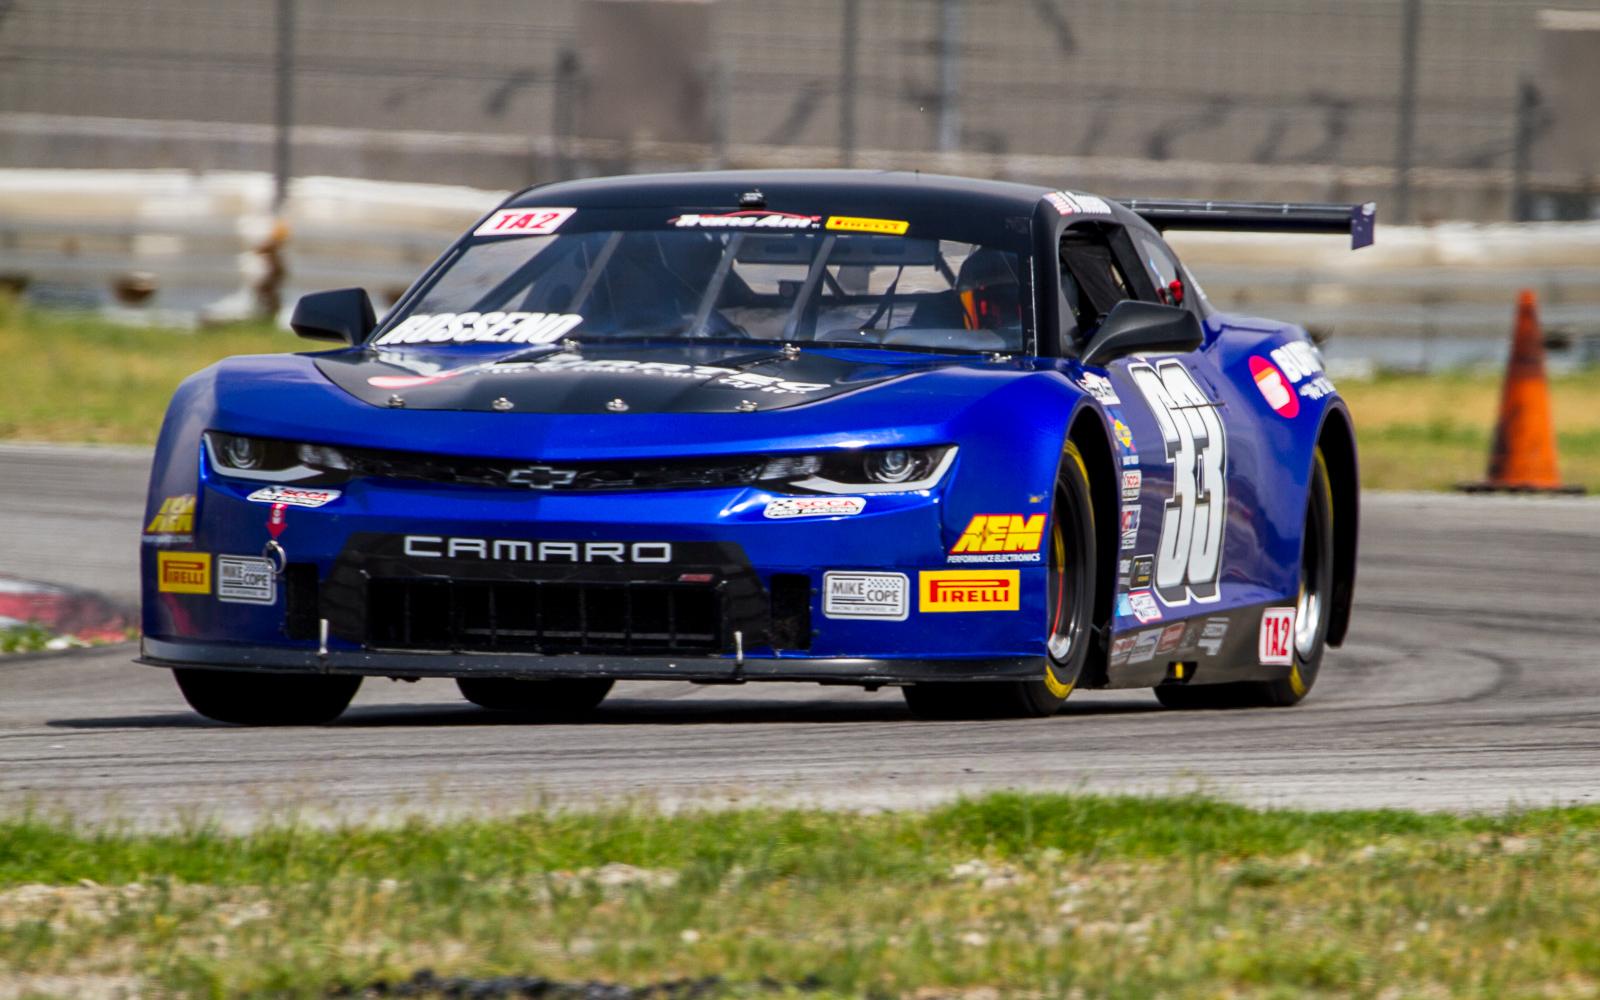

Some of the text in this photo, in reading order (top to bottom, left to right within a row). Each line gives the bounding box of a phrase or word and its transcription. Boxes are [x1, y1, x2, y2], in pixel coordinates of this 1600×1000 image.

[494, 212, 560, 230] TA2
[1128, 358, 1227, 607] 33
[950, 513, 1048, 554] AEM
[404, 535, 672, 563] CAMARO
[163, 560, 205, 585] PIRELLI
[243, 572, 269, 587] COPE
[831, 582, 865, 595] MIKE
[866, 589, 899, 602] COPE
[930, 579, 1010, 603] PIRELLI
[1264, 616, 1291, 657] TA2
